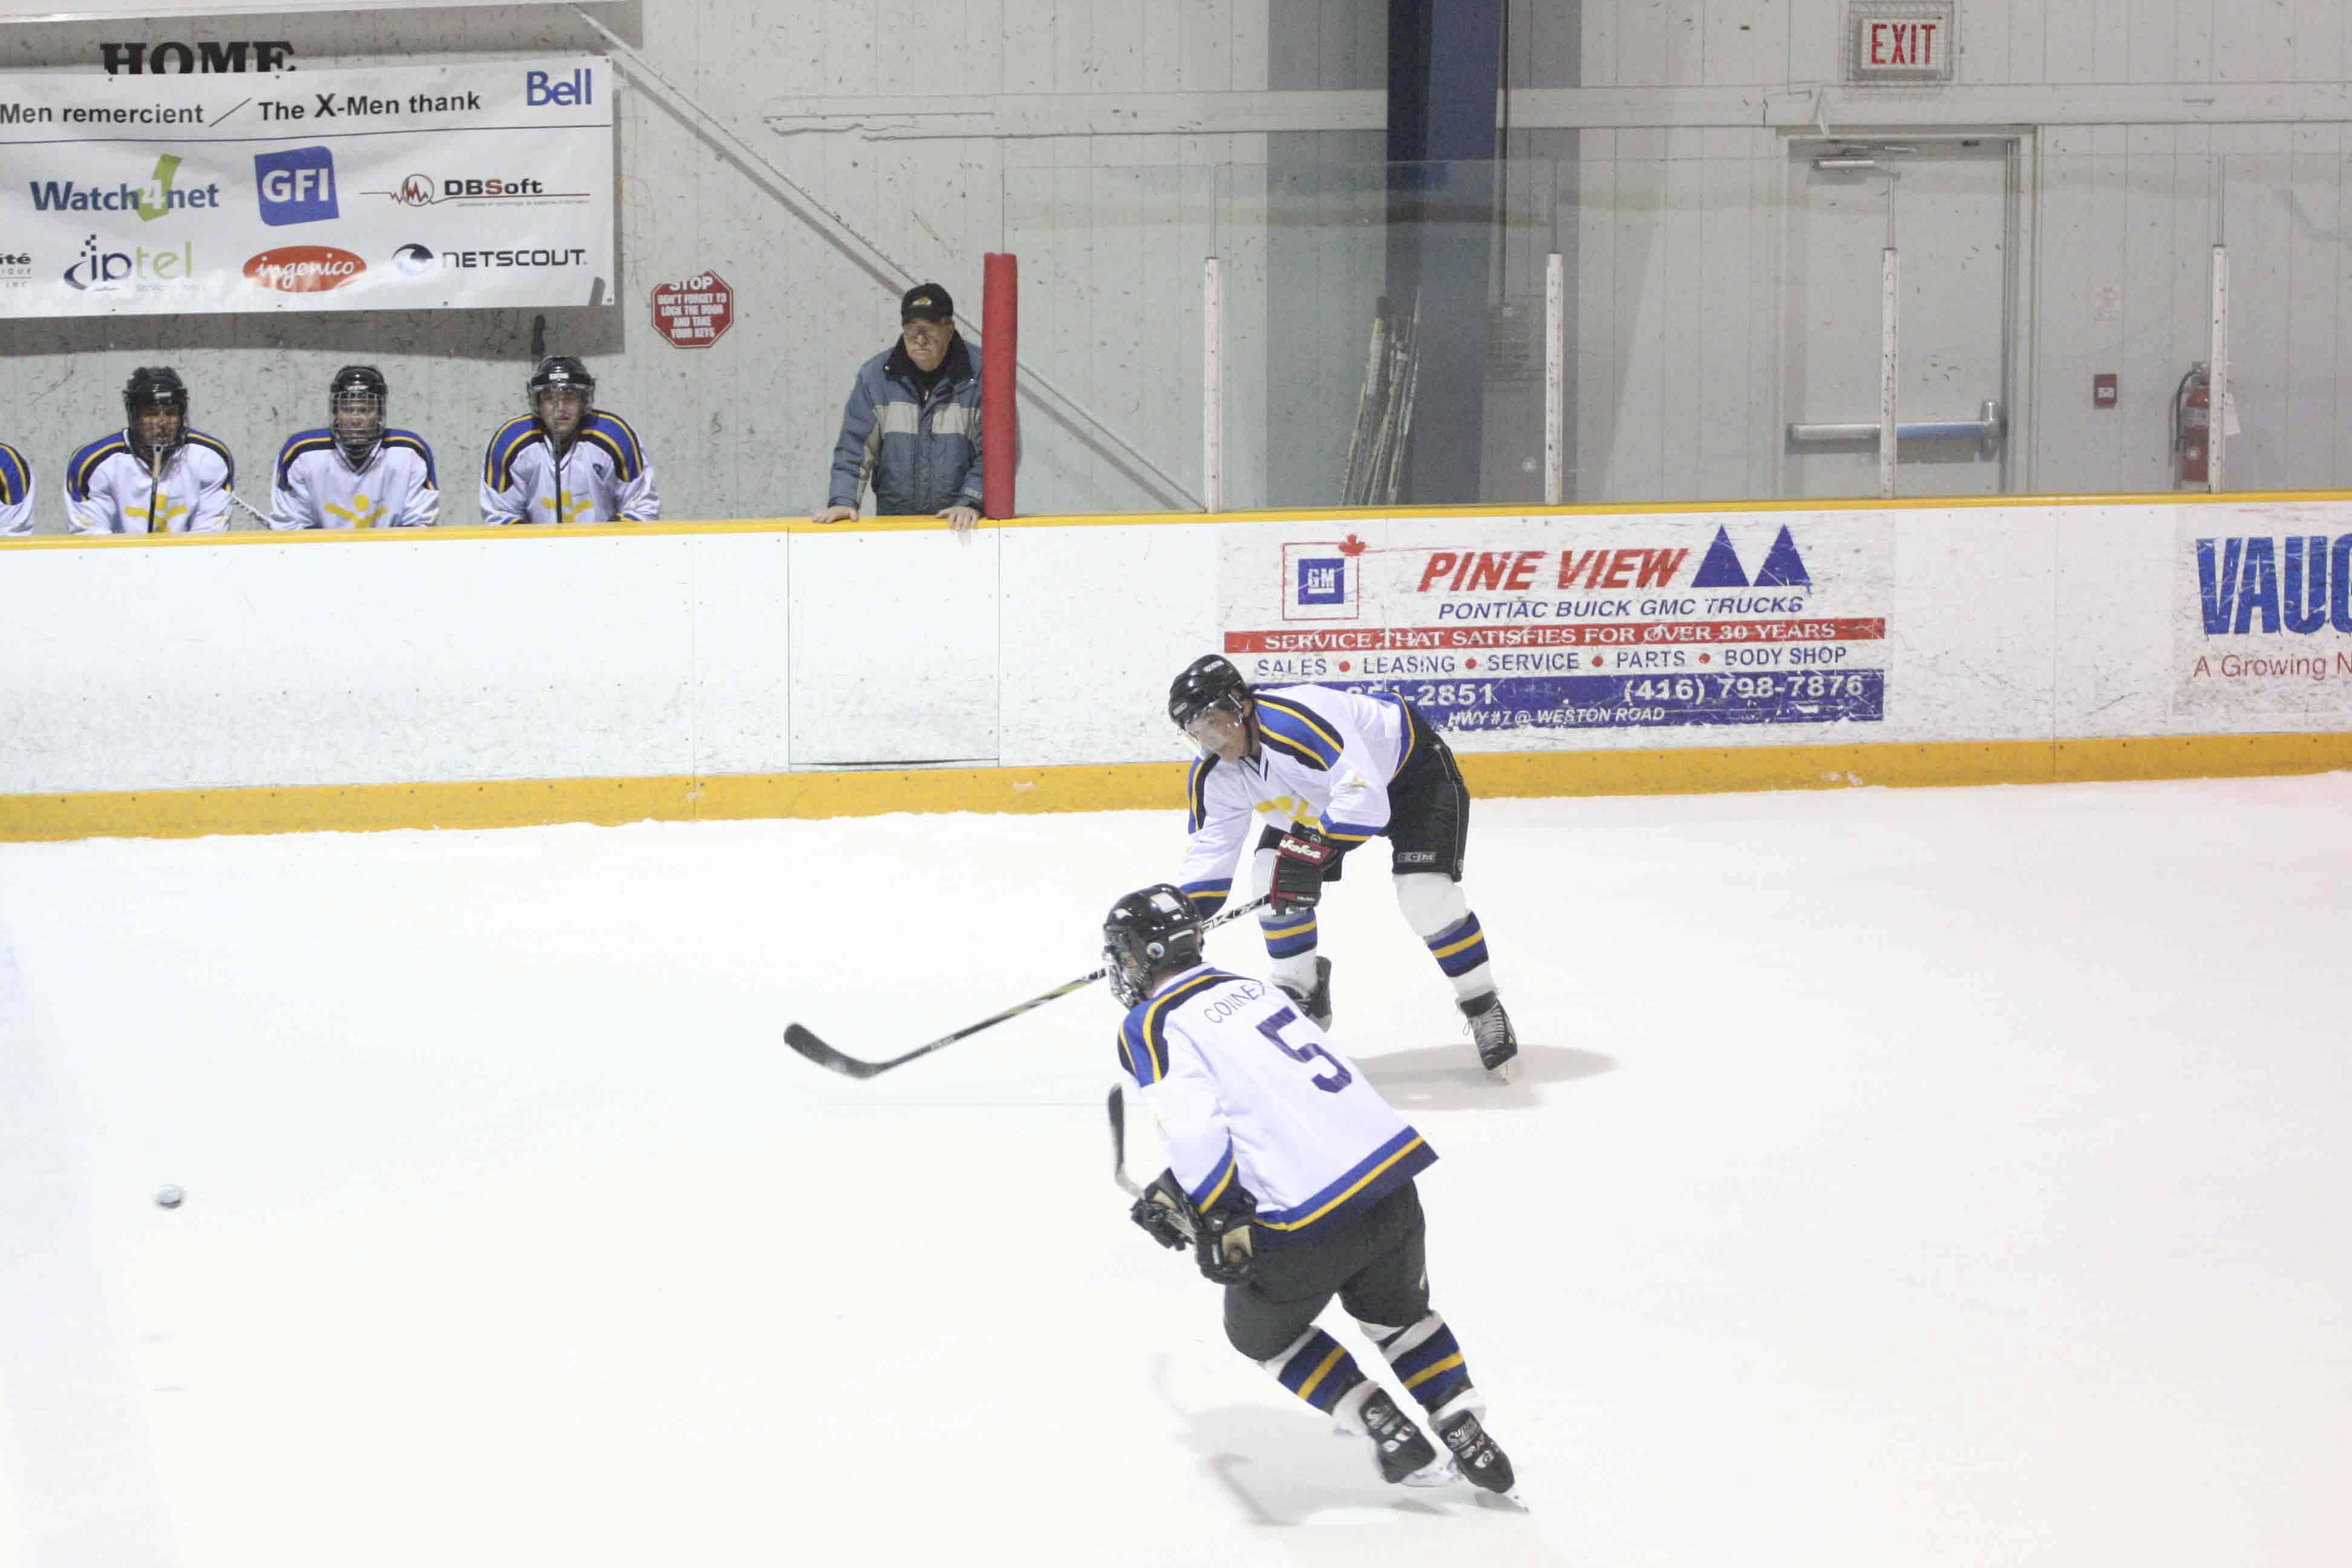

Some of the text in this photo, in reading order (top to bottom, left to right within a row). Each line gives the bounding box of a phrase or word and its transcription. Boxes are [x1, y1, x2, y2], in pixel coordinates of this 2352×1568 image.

[99, 41, 296, 74] HOME
[1871, 24, 1936, 64] EXIT
[527, 68, 592, 106] Bell
[62, 103, 204, 123] remercient
[258, 102, 305, 121] The
[315, 93, 399, 117] X-Men
[410, 91, 481, 113] thank
[30, 165, 220, 213] Watch4net
[262, 168, 329, 203] GFI
[445, 178, 543, 195] DBSoft
[256, 252, 354, 289] ingenico
[669, 276, 713, 291] STOP
[1308, 567, 1335, 589] GM
[1417, 547, 1690, 592] PINE VIEW
[1439, 595, 1804, 620] PONTIAC BUICK GMC TRUCKS
[1264, 622, 1837, 650] SERVICE THAT SATISFIES FOR OVER 30 YEARS
[1258, 646, 1847, 676] SALES LEASING SERVICE PARTS BODY SHOP
[2194, 655, 2211, 678] A
[2221, 654, 2327, 681] Growing
[1624, 677, 1706, 707] (416)
[1718, 675, 1864, 700] 798-7876
[1448, 710, 1490, 725] HWY
[1514, 711, 1531, 724] @
[1537, 708, 1612, 725] WESTON
[1615, 707, 1665, 722] ROAD
[1397, 852, 1434, 863] CCM
[1255, 1005, 1352, 1094] 5
